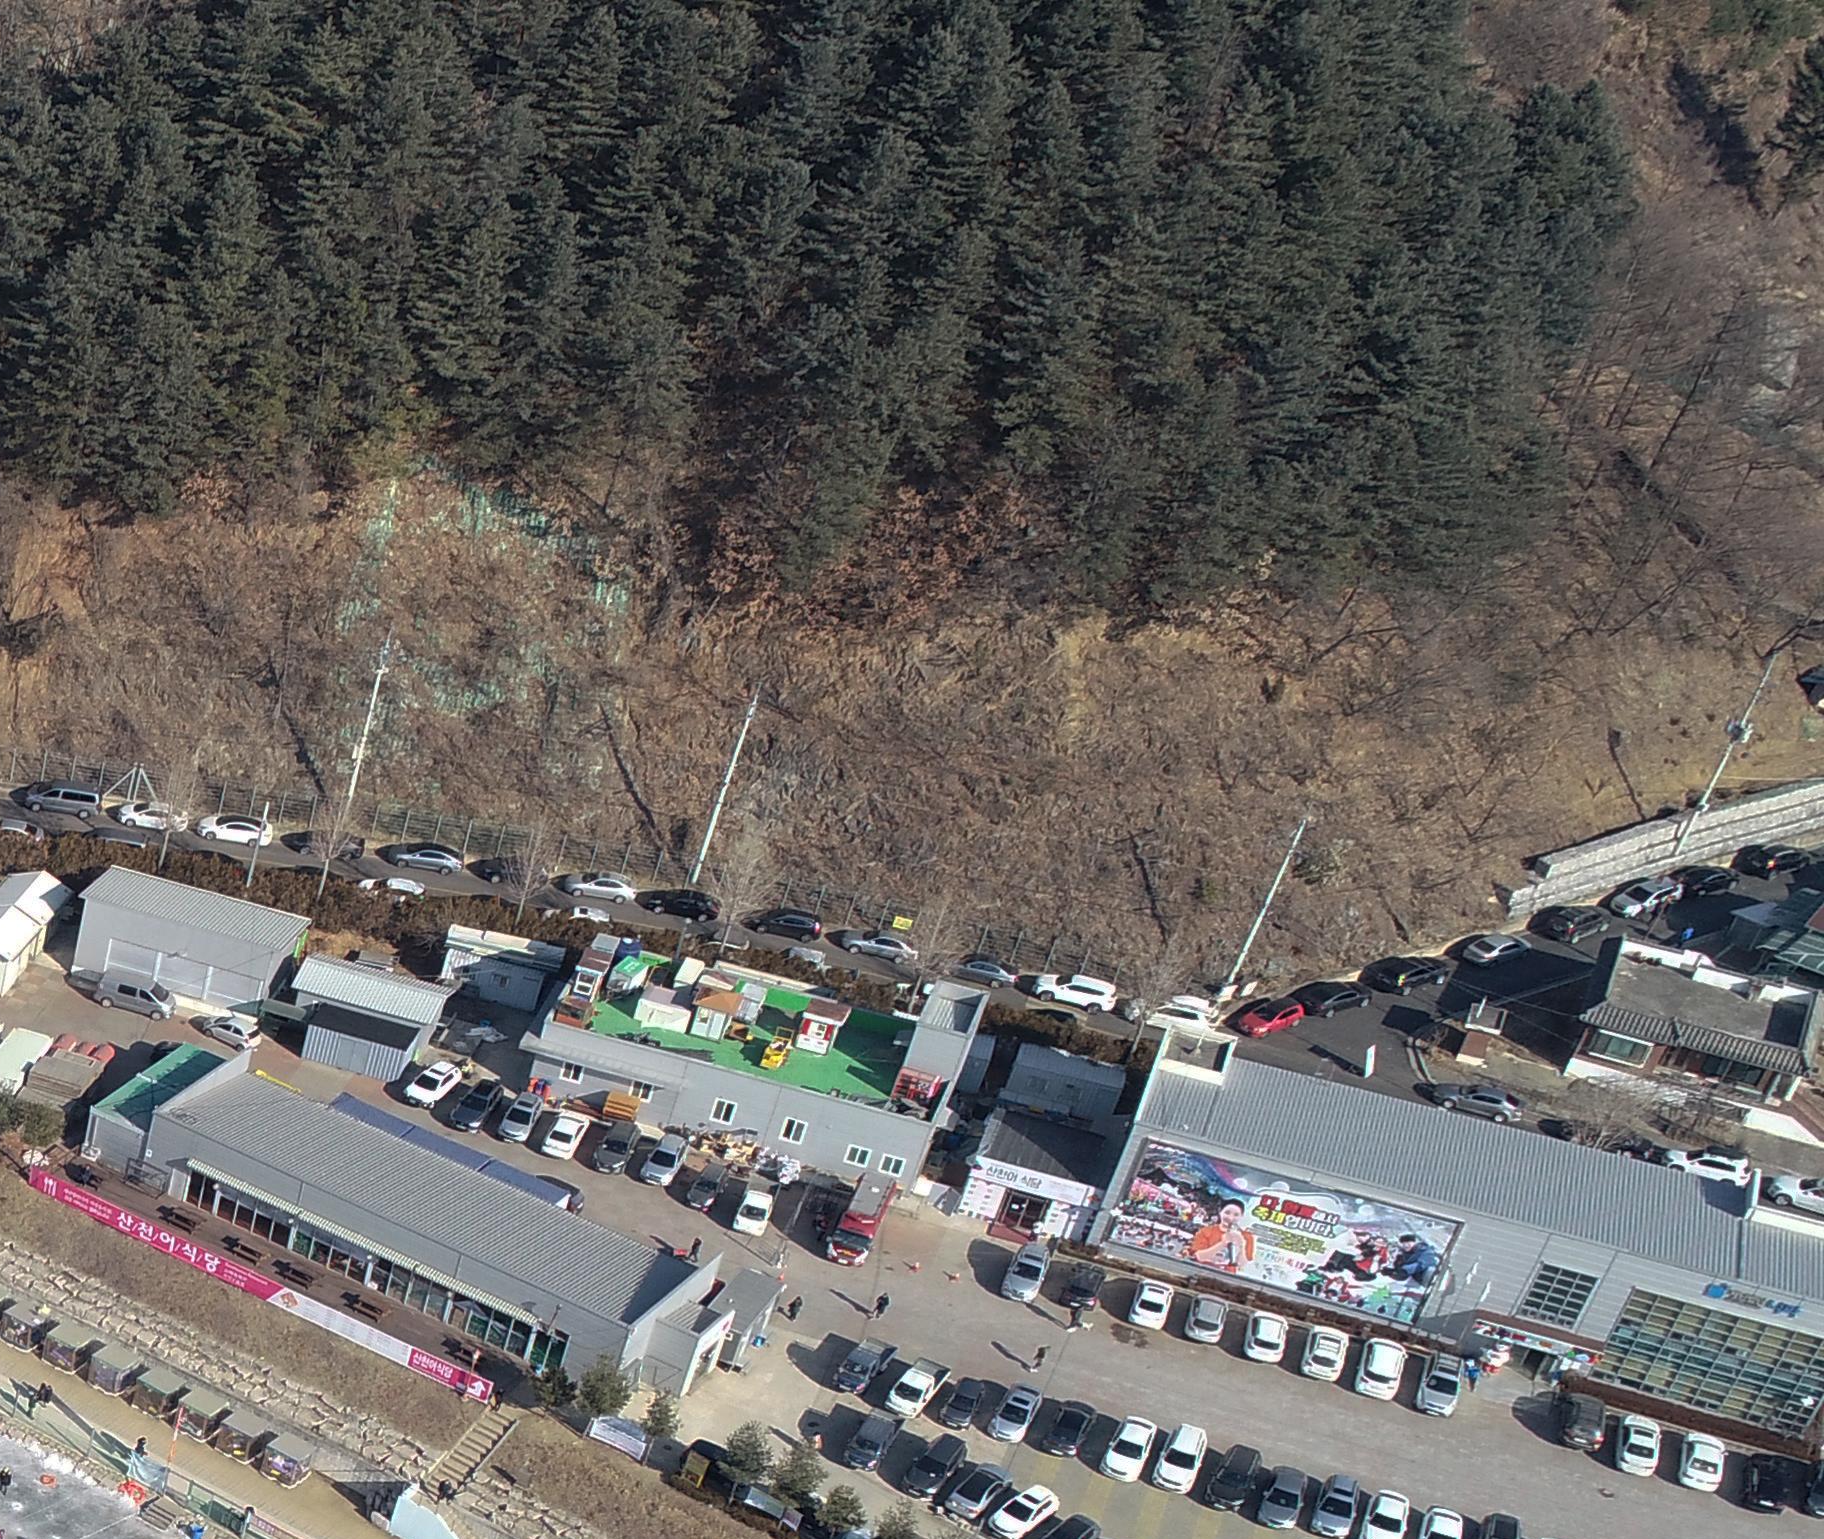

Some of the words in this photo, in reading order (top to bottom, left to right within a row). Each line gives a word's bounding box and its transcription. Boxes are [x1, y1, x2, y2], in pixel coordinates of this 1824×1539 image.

[986, 1166, 1018, 1182] 산천어
[1021, 1175, 1043, 1189] 식당
[412, 1352, 454, 1379] 산천어식당
